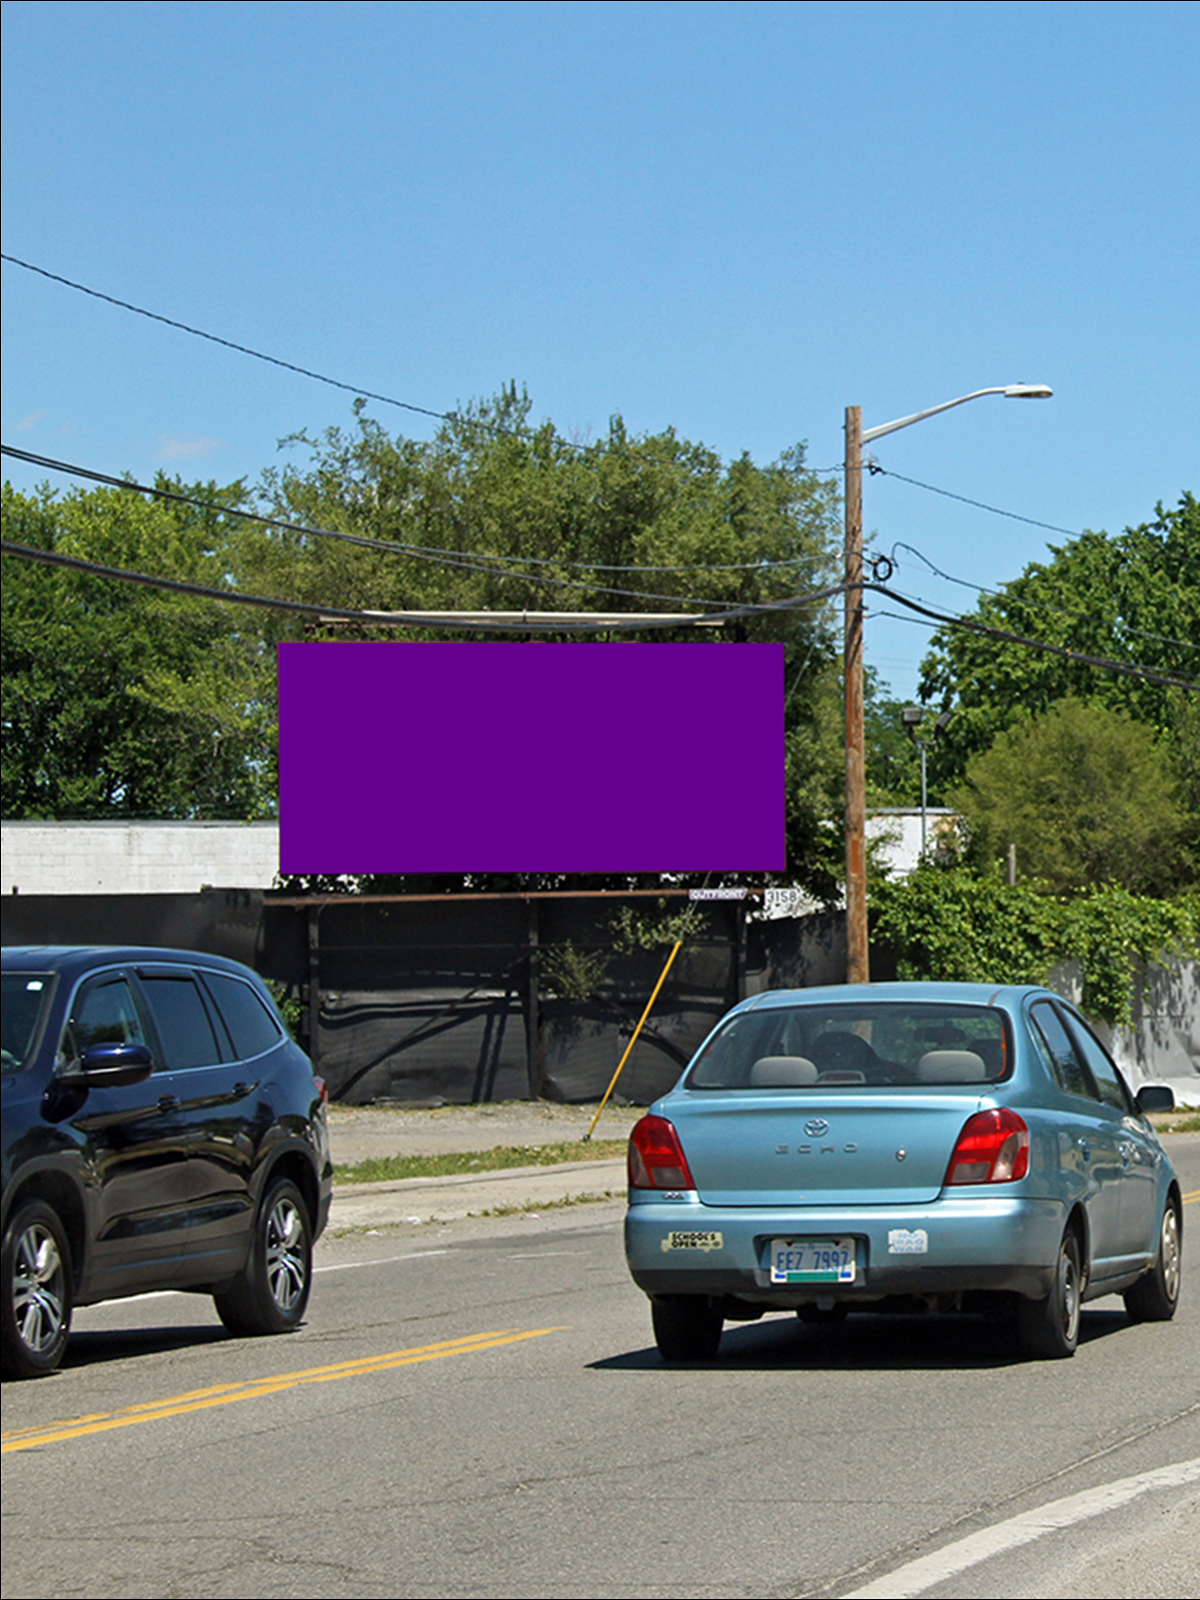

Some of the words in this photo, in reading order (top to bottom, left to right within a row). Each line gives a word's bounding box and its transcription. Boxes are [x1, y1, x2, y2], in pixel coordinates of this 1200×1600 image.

[767, 891, 797, 903] 3158
[775, 1143, 858, 1154] ECHO
[671, 1240, 697, 1248] OPEN
[814, 1251, 848, 1271] 7997
